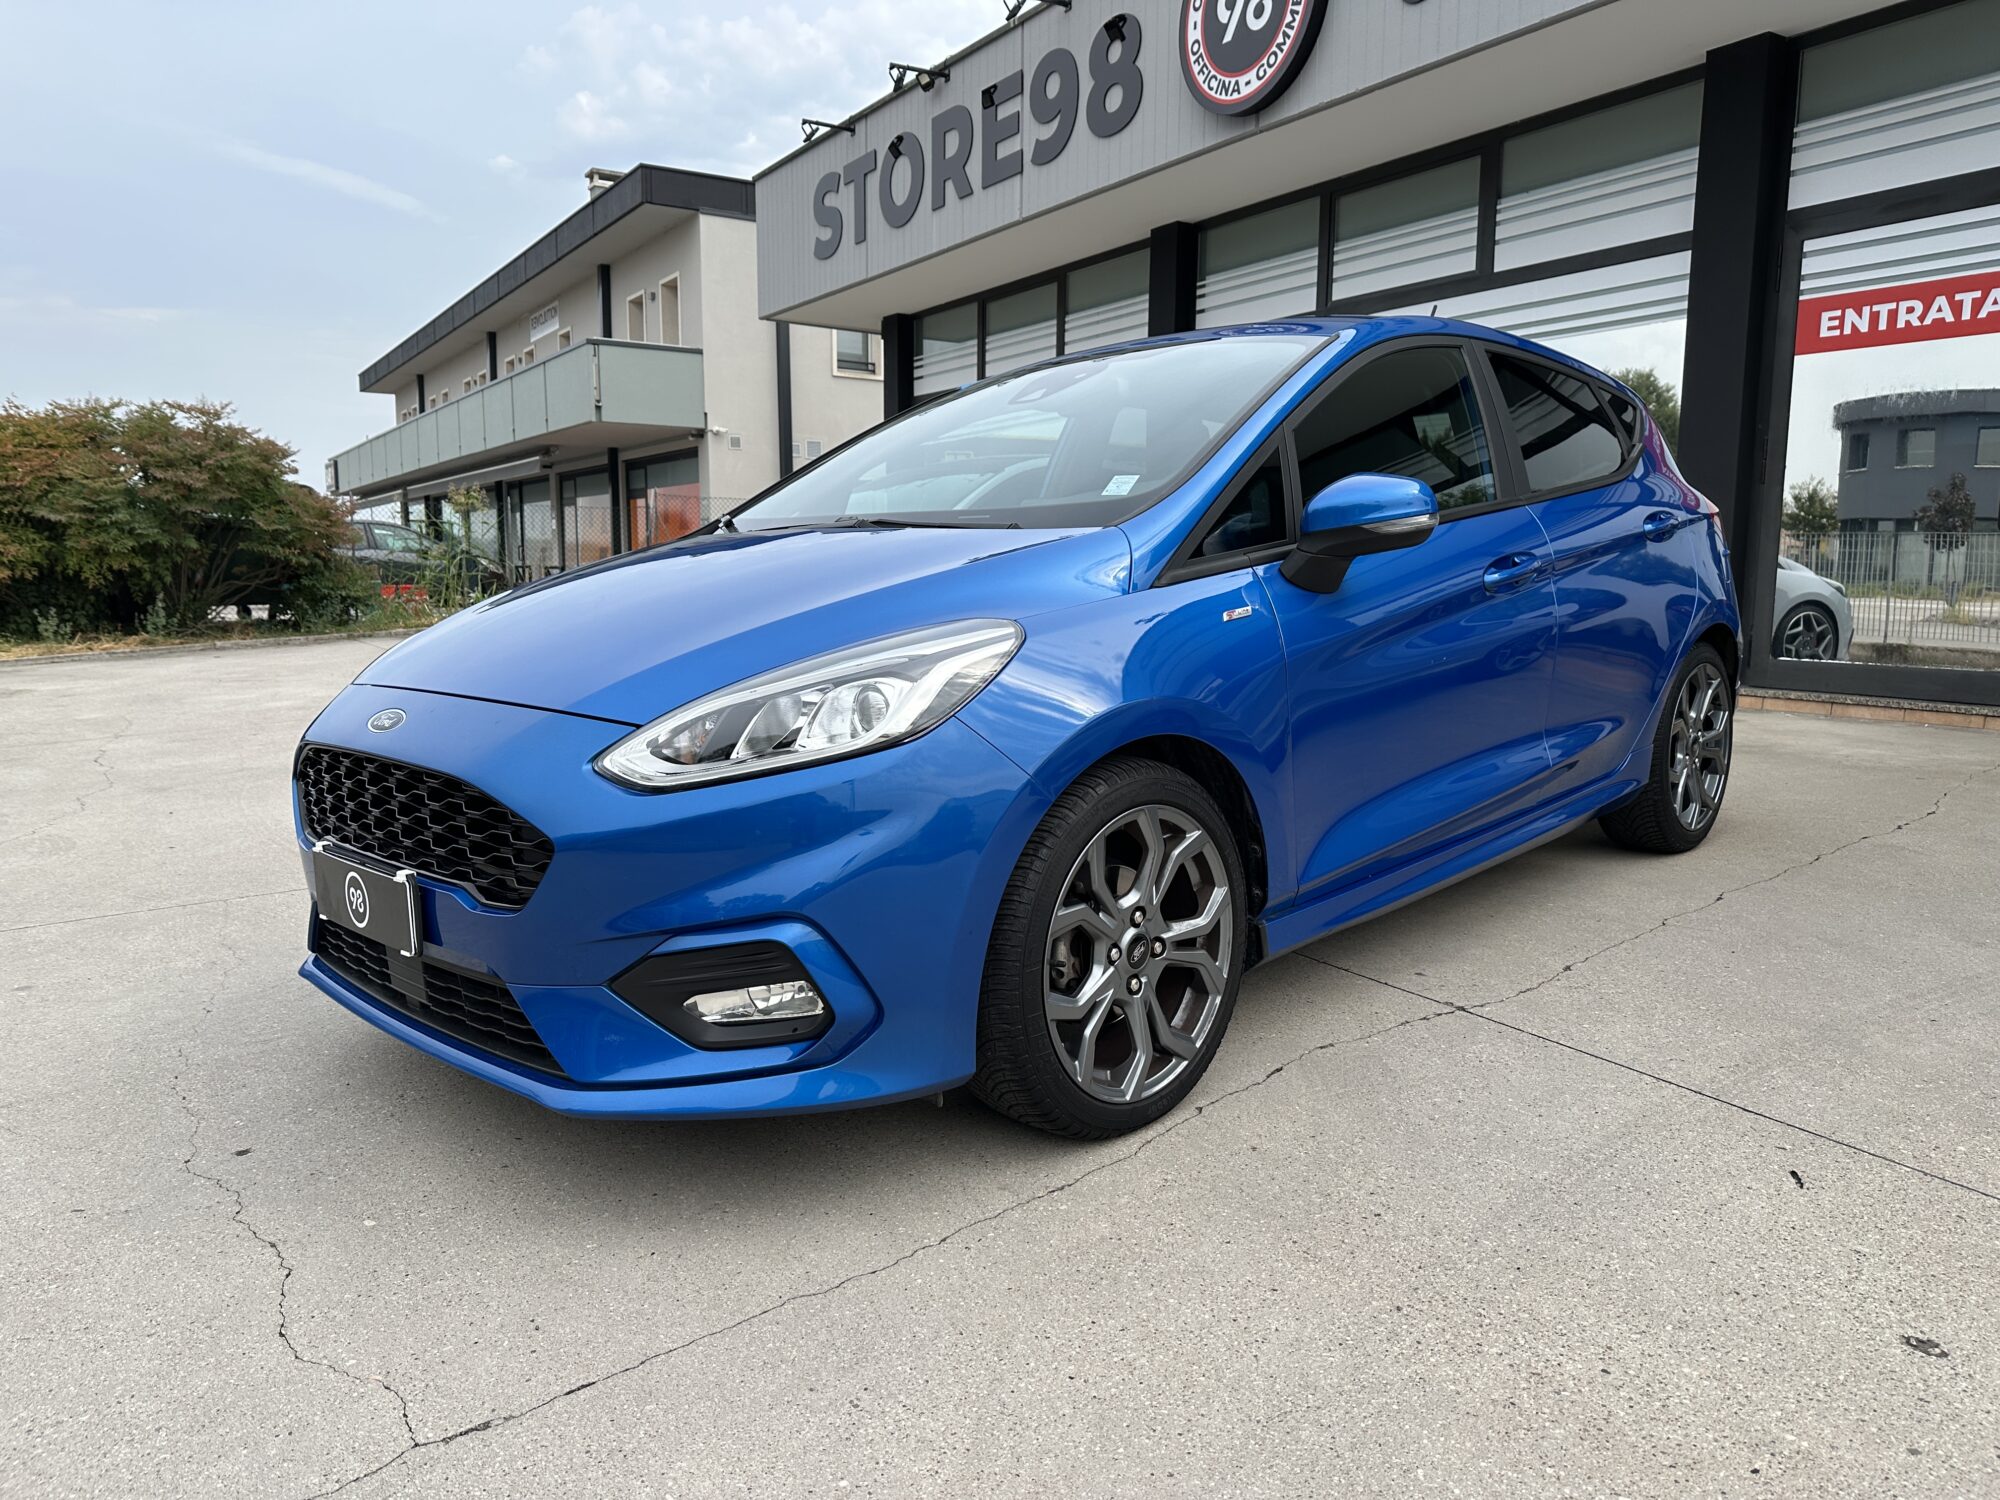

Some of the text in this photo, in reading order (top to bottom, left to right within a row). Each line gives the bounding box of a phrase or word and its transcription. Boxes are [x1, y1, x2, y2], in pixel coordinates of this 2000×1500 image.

[1191, 39, 1241, 97] OFFICINA
[813, 13, 1143, 260] STORE98
[1819, 288, 2000, 338] ENTRATA
